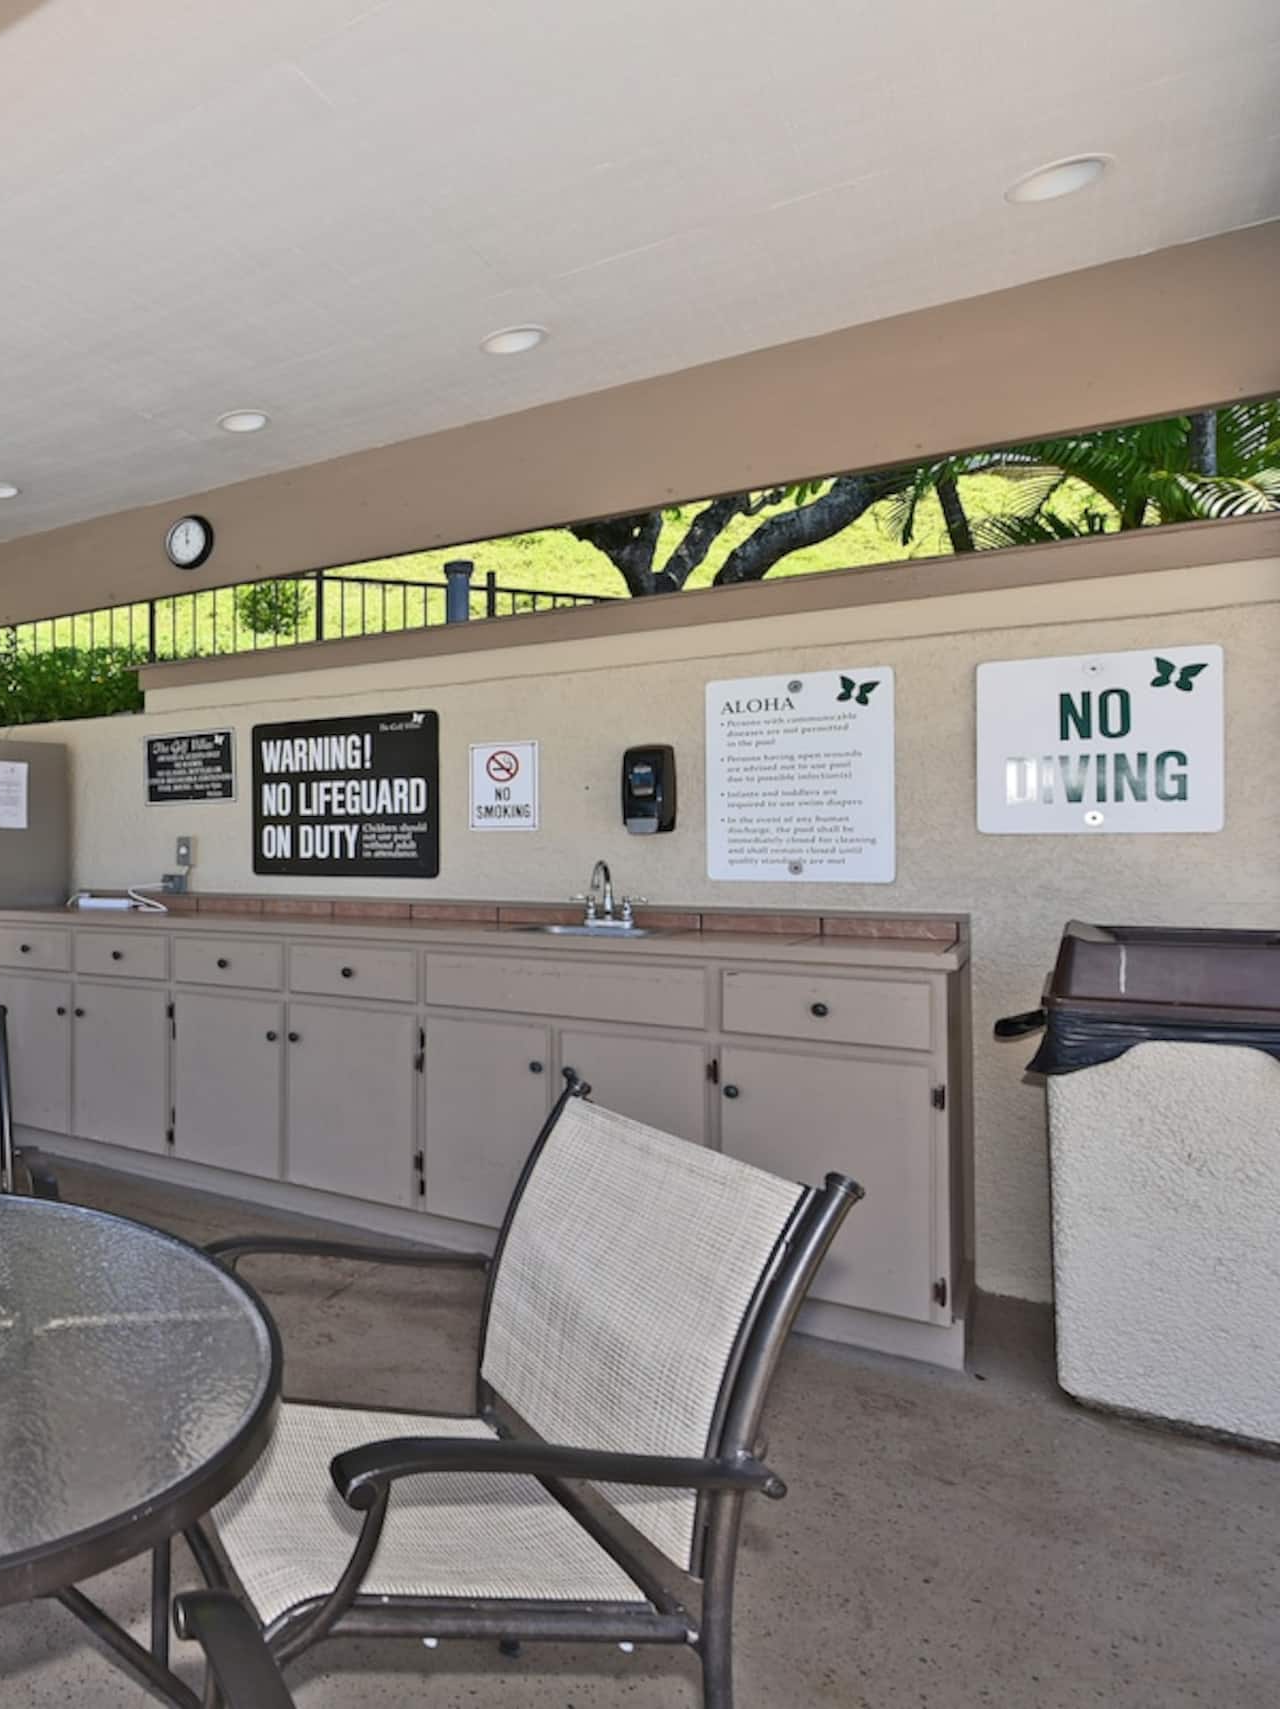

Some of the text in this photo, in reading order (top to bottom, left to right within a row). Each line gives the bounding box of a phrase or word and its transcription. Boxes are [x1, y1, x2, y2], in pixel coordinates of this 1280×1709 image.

[720, 696, 796, 715] ALOHA
[1059, 688, 1131, 741] NO
[152, 742, 169, 754] The
[170, 739, 189, 754] Golf
[261, 733, 372, 774] WARNING!
[1005, 750, 1188, 806] DIVING
[262, 777, 427, 817] NO LIFEGUARD
[495, 786, 511, 801] NO
[476, 804, 531, 820] SMOKING
[362, 821, 428, 832] Children should
[262, 824, 361, 859] ON DUTY
[362, 831, 413, 842] not use pool
[362, 840, 394, 850] without
